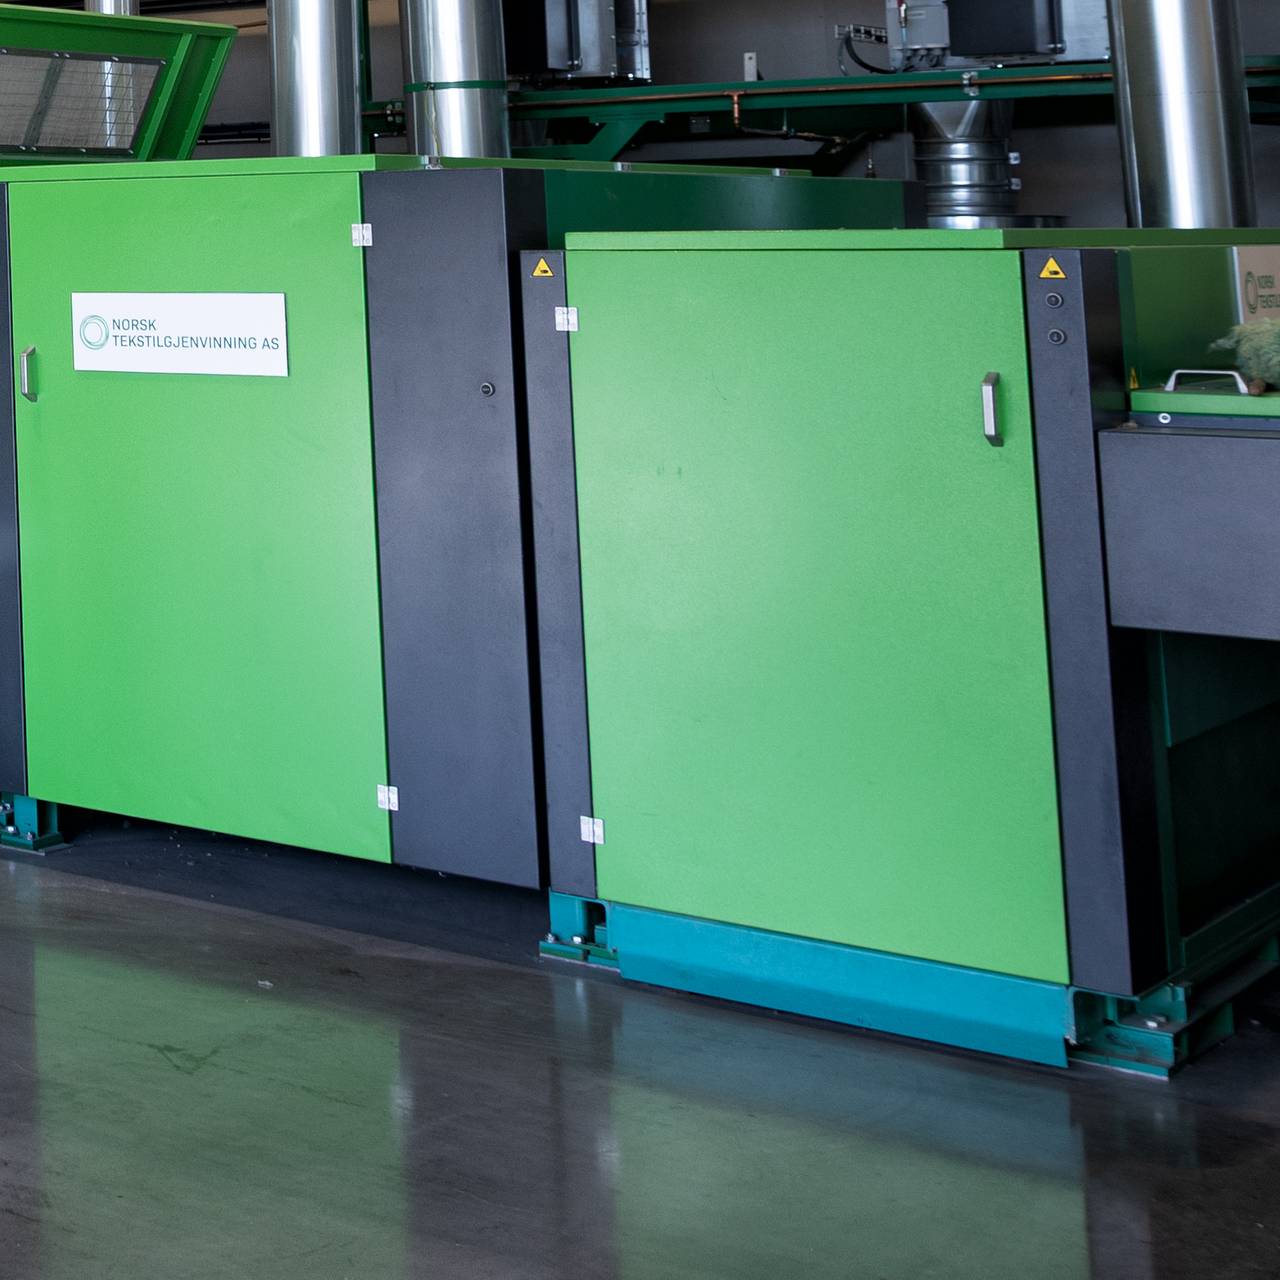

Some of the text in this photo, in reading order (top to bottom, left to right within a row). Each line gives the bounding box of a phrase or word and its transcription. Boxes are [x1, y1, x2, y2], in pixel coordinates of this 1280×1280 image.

[112, 318, 157, 331] NORSK
[112, 334, 280, 350] TEKSTILGJENVINNING AS
